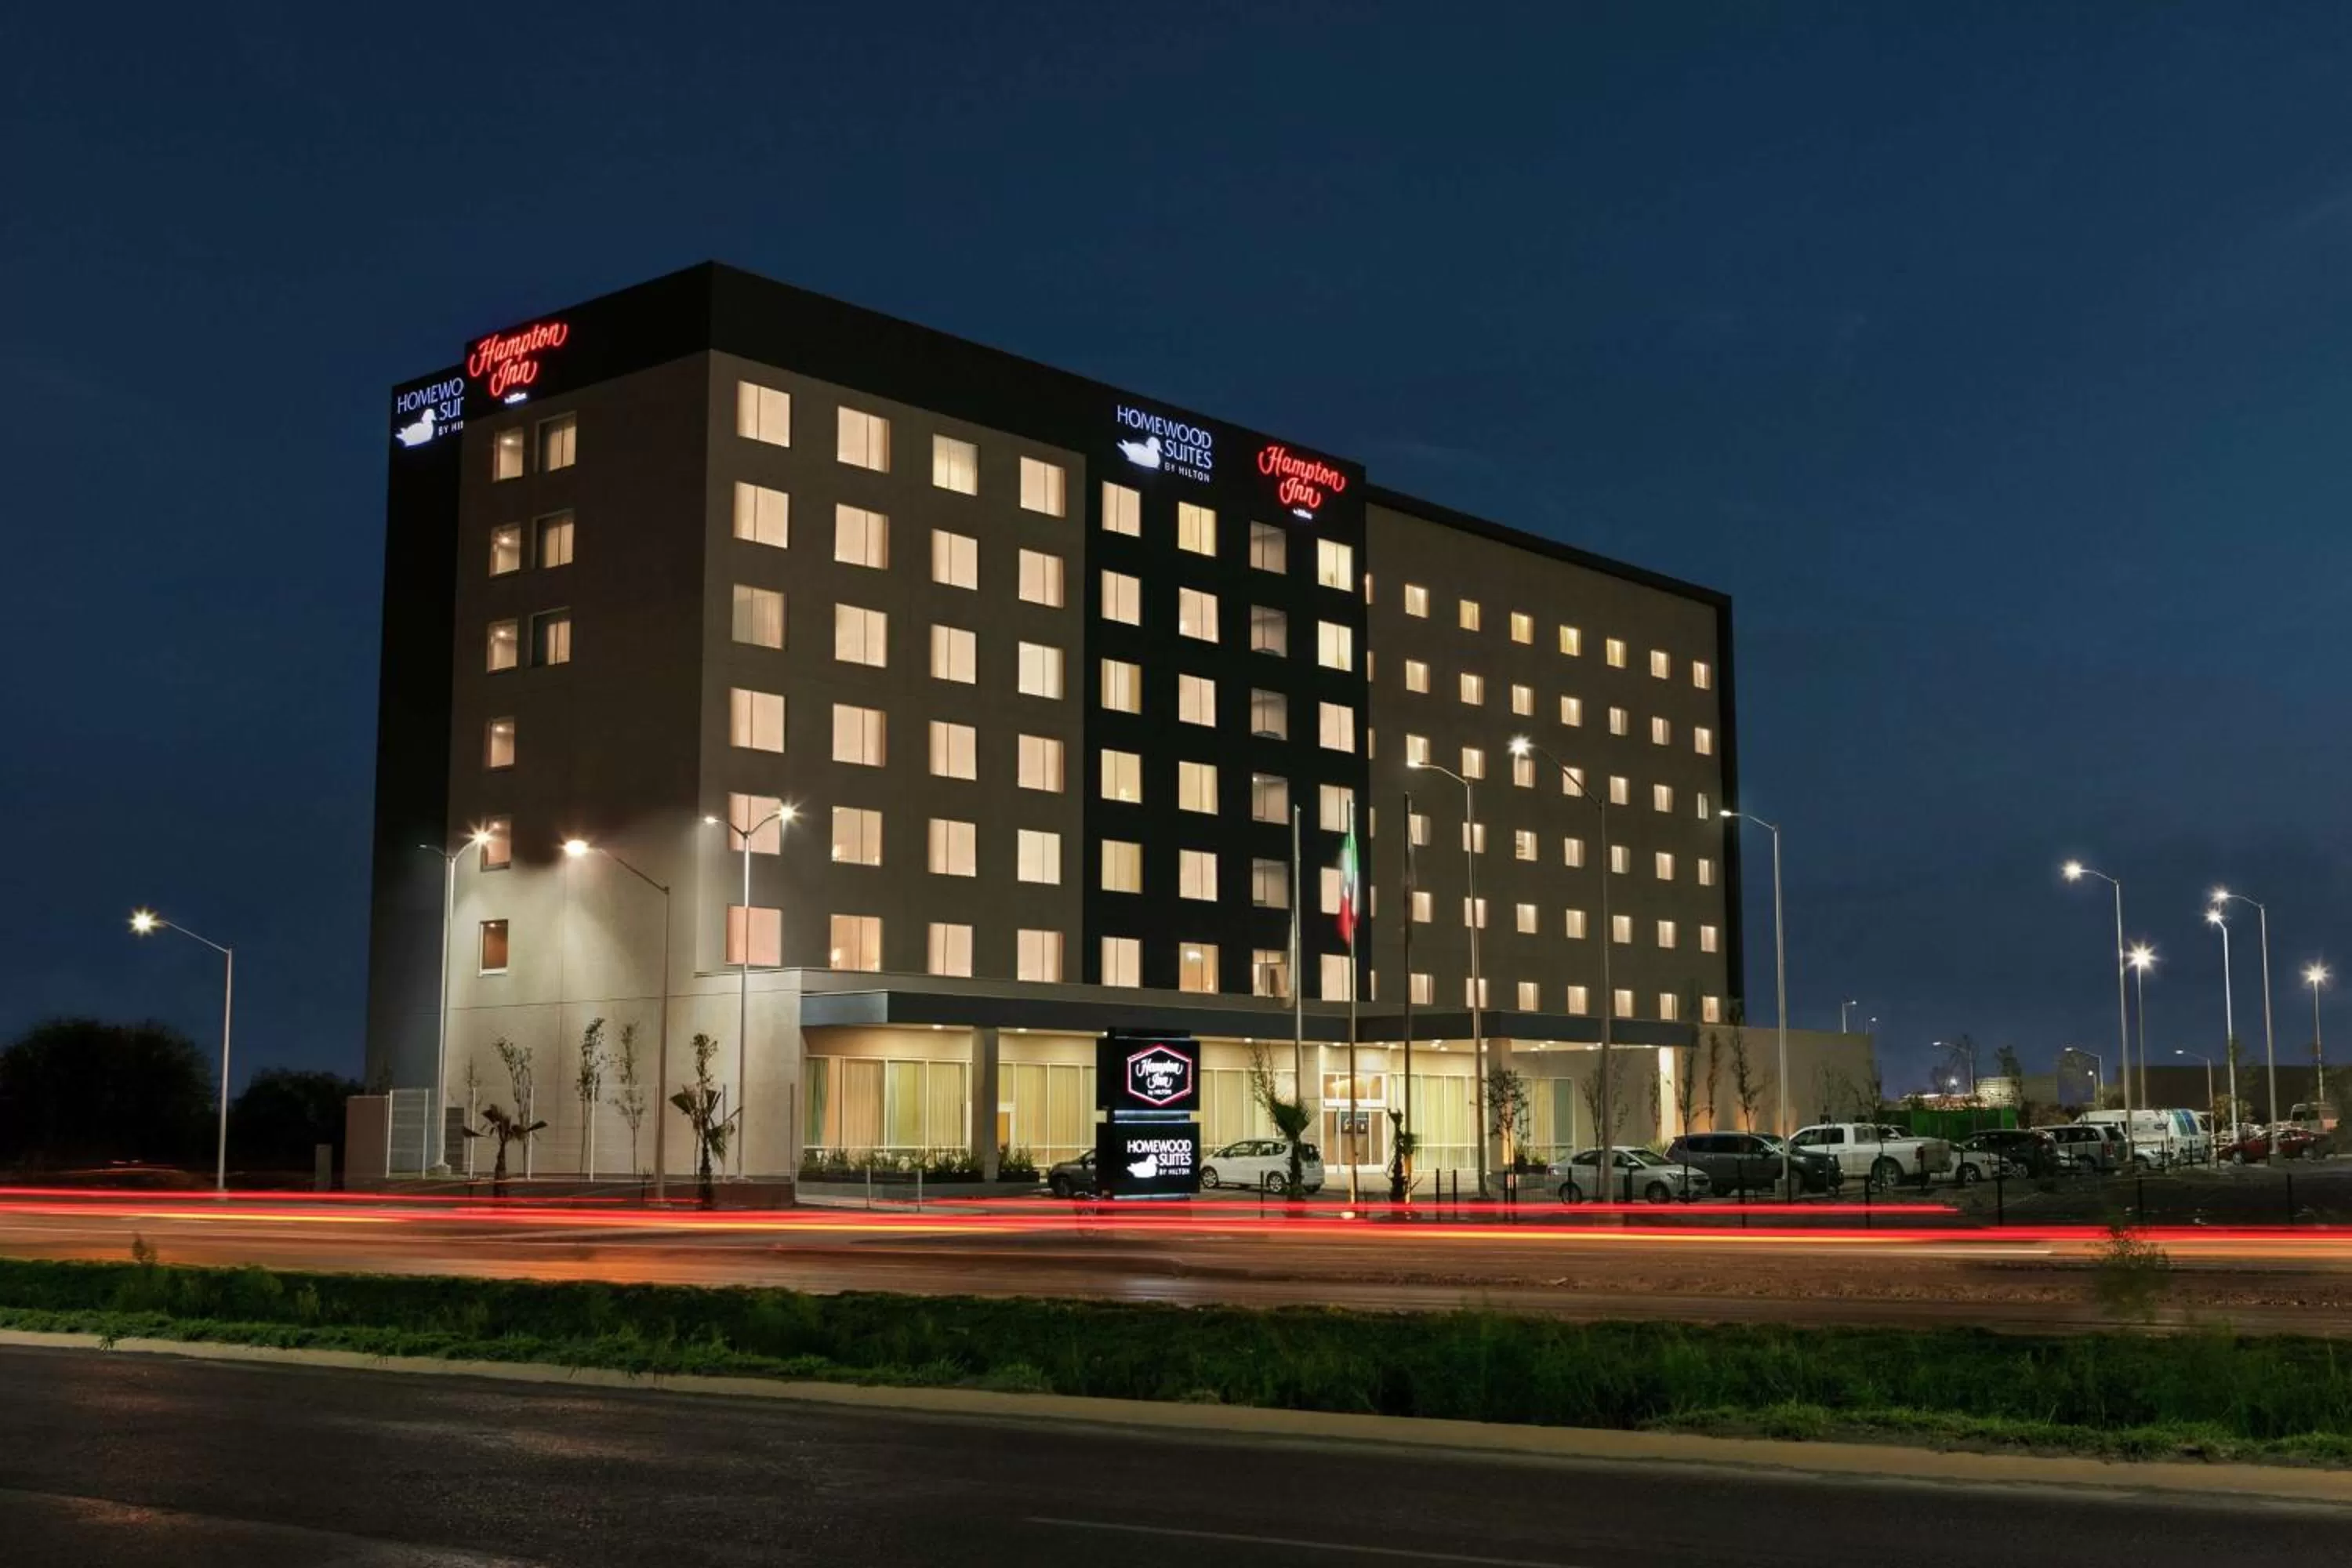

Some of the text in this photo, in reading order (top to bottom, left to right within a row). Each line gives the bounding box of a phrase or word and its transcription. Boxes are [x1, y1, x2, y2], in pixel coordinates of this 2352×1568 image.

[470, 323, 568, 377] Hampton
[491, 359, 538, 396] Inn
[397, 377, 465, 414] HOMEWO
[438, 426, 450, 437] BY
[1116, 405, 1212, 449] HOMEWOOD
[1165, 439, 1212, 470] SUITES
[1258, 446, 1345, 492] Hampton
[1165, 462, 1210, 482] BY HILTON
[1279, 477, 1321, 508] Inn
[1135, 1058, 1183, 1077] Hampton
[1146, 1074, 1173, 1088] Inn
[1127, 1139, 1192, 1153] HOMEWOOD
[1159, 1153, 1192, 1166] SUITES
